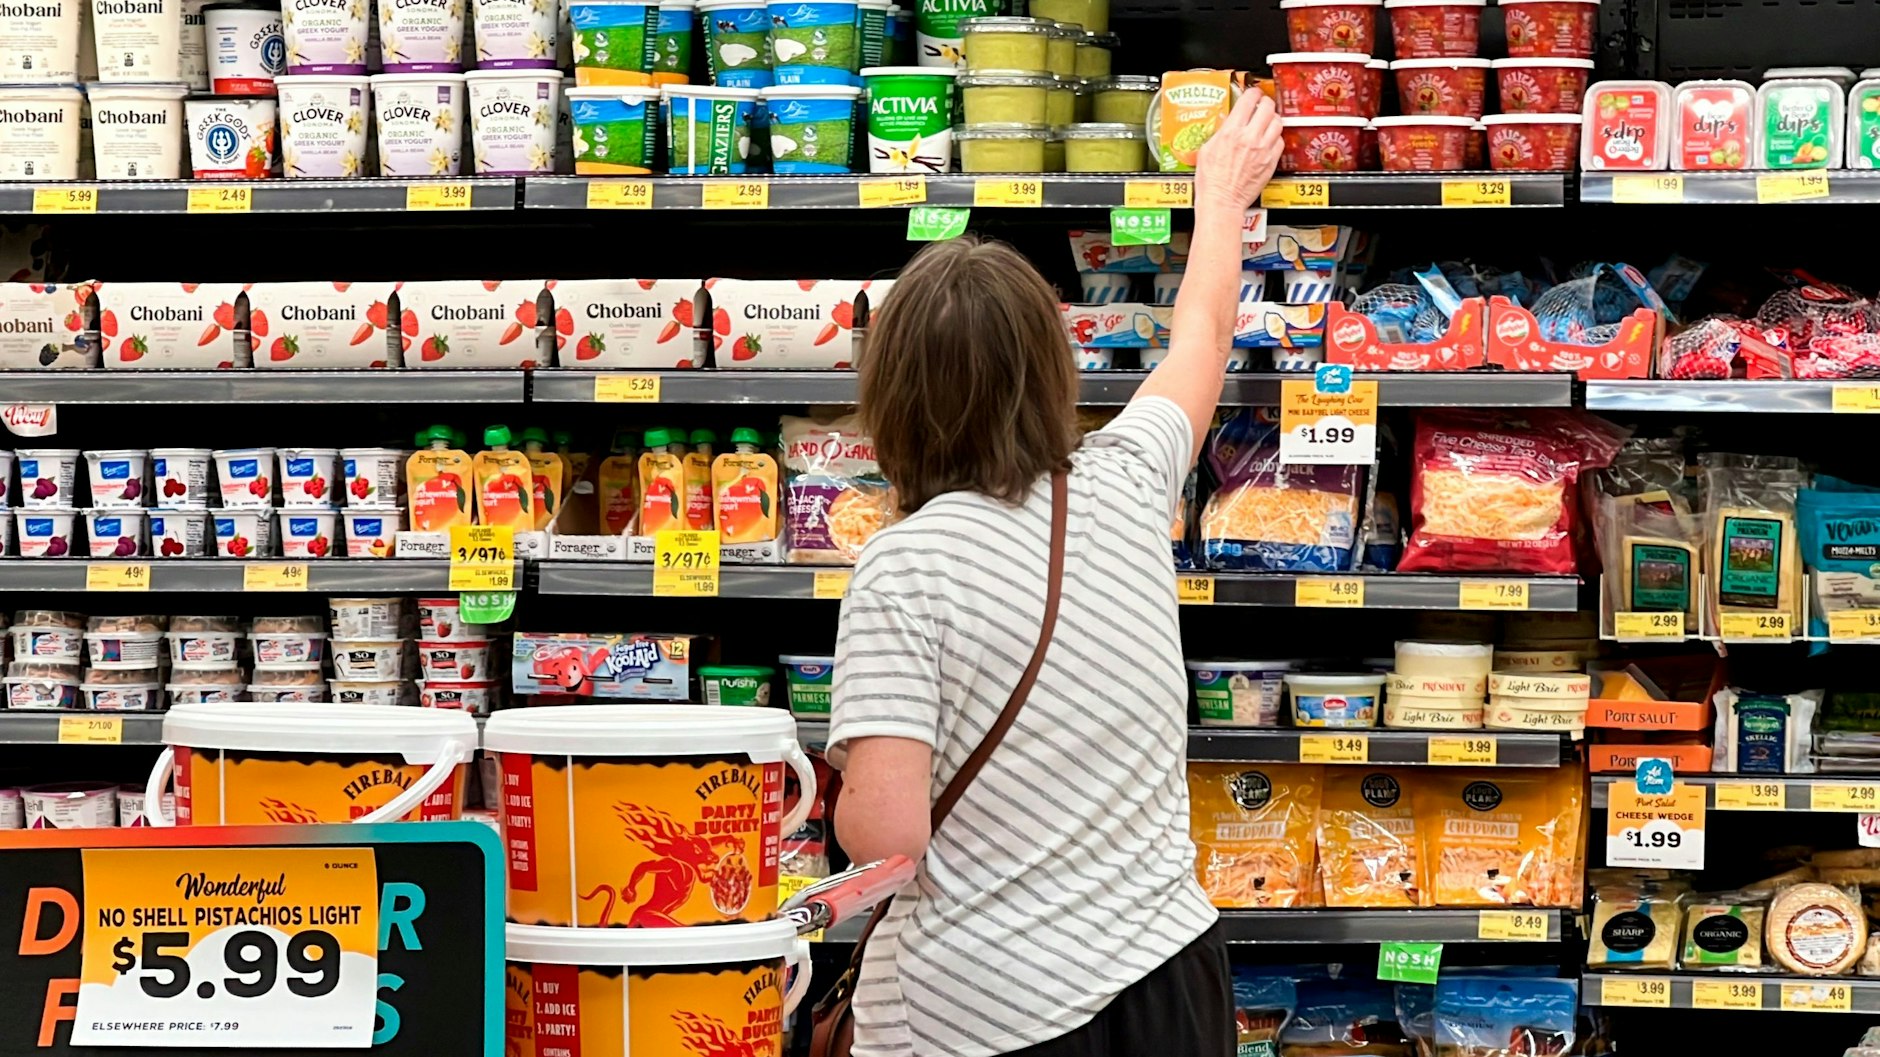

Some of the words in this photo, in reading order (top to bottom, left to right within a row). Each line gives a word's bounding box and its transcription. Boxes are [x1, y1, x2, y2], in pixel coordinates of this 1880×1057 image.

[402, 17, 442, 25] ORGANIC
[780, 75, 800, 84] PLAIN
[1168, 86, 1225, 101] WHOLLY
[480, 101, 531, 118] CLOVER
[872, 96, 938, 114] ACTIVIA
[98, 109, 167, 125] Chobani
[293, 108, 344, 124] CLOVER
[383, 106, 431, 123] CLOVER
[387, 130, 425, 138] ORGANIC
[486, 126, 526, 134] ORGANIC
[317, 139, 345, 147] YOGURT
[503, 134, 532, 142] YOGURT
[1115, 215, 1166, 226] NOSH
[130, 305, 203, 322] Chobani
[281, 304, 356, 321] Chobani
[431, 304, 505, 321] Chobani
[586, 302, 662, 319] Chobani
[743, 303, 820, 320] Chobani
[1301, 427, 1355, 444] $1.99
[1477, 431, 1536, 448] SHREDDED
[1432, 432, 1459, 446] Five
[1459, 436, 1508, 454] Cheese
[400, 540, 445, 554] Forager
[555, 541, 600, 555] Forager
[125, 567, 144, 578] 49¢
[282, 567, 302, 578] 49¢
[669, 642, 684, 654] 12
[605, 643, 659, 674] Kool-Aid
[1507, 682, 1530, 693] Light
[1535, 682, 1560, 694] Brie
[793, 692, 831, 704] PARMESA
[1403, 711, 1425, 724] Light
[1429, 712, 1455, 723] Brie
[1522, 713, 1548, 726] Light
[1610, 754, 1637, 768] POR
[343, 768, 413, 801] FIREBAL
[695, 768, 760, 801] FIREBALL
[701, 803, 757, 820] PARTY
[1616, 811, 1653, 820] CHEESE
[1658, 812, 1694, 821] WEDGE
[694, 818, 760, 835] BUCKET
[1626, 831, 1682, 848] $1.99
[176, 872, 286, 904] Wonderful
[99, 908, 125, 927] NO
[132, 907, 188, 926] SHELL
[195, 905, 303, 927] PISTACHIOS
[309, 905, 362, 925] LIGHT
[1612, 928, 1645, 937] SHARP
[1699, 930, 1743, 939] ORGANIC
[111, 929, 341, 999] $5.99
[543, 982, 559, 994] BUY
[544, 1003, 561, 1015] ADD
[562, 1003, 577, 1016] ICE
[92, 1021, 165, 1031] ELSEWHERE
[169, 1021, 206, 1031] PRICE:
[210, 1021, 239, 1031] $7.99
[545, 1023, 576, 1037] PARTY!
[1237, 1041, 1270, 1055] Blend
